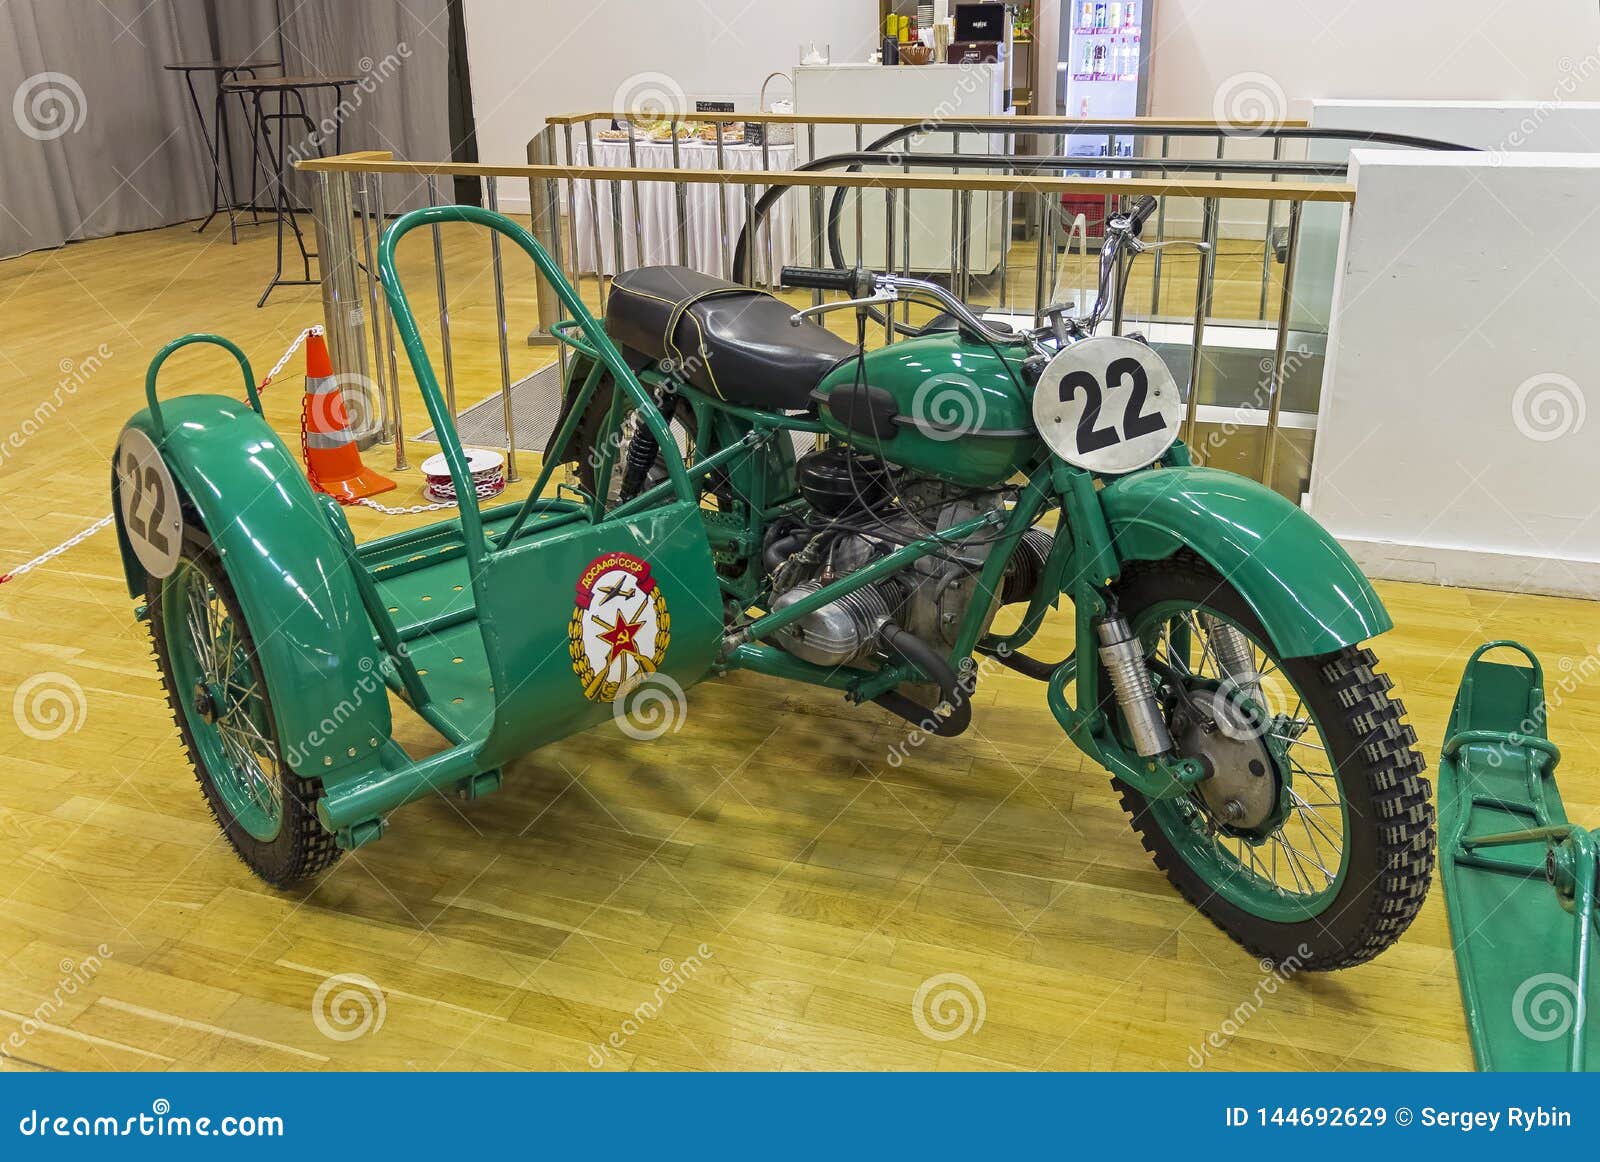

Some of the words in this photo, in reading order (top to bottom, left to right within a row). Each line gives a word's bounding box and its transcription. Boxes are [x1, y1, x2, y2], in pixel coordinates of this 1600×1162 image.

[1059, 357, 1167, 455] 22
[127, 452, 169, 556] 22
[582, 558, 616, 589] ДОСААФ
[618, 559, 643, 572] СССР
